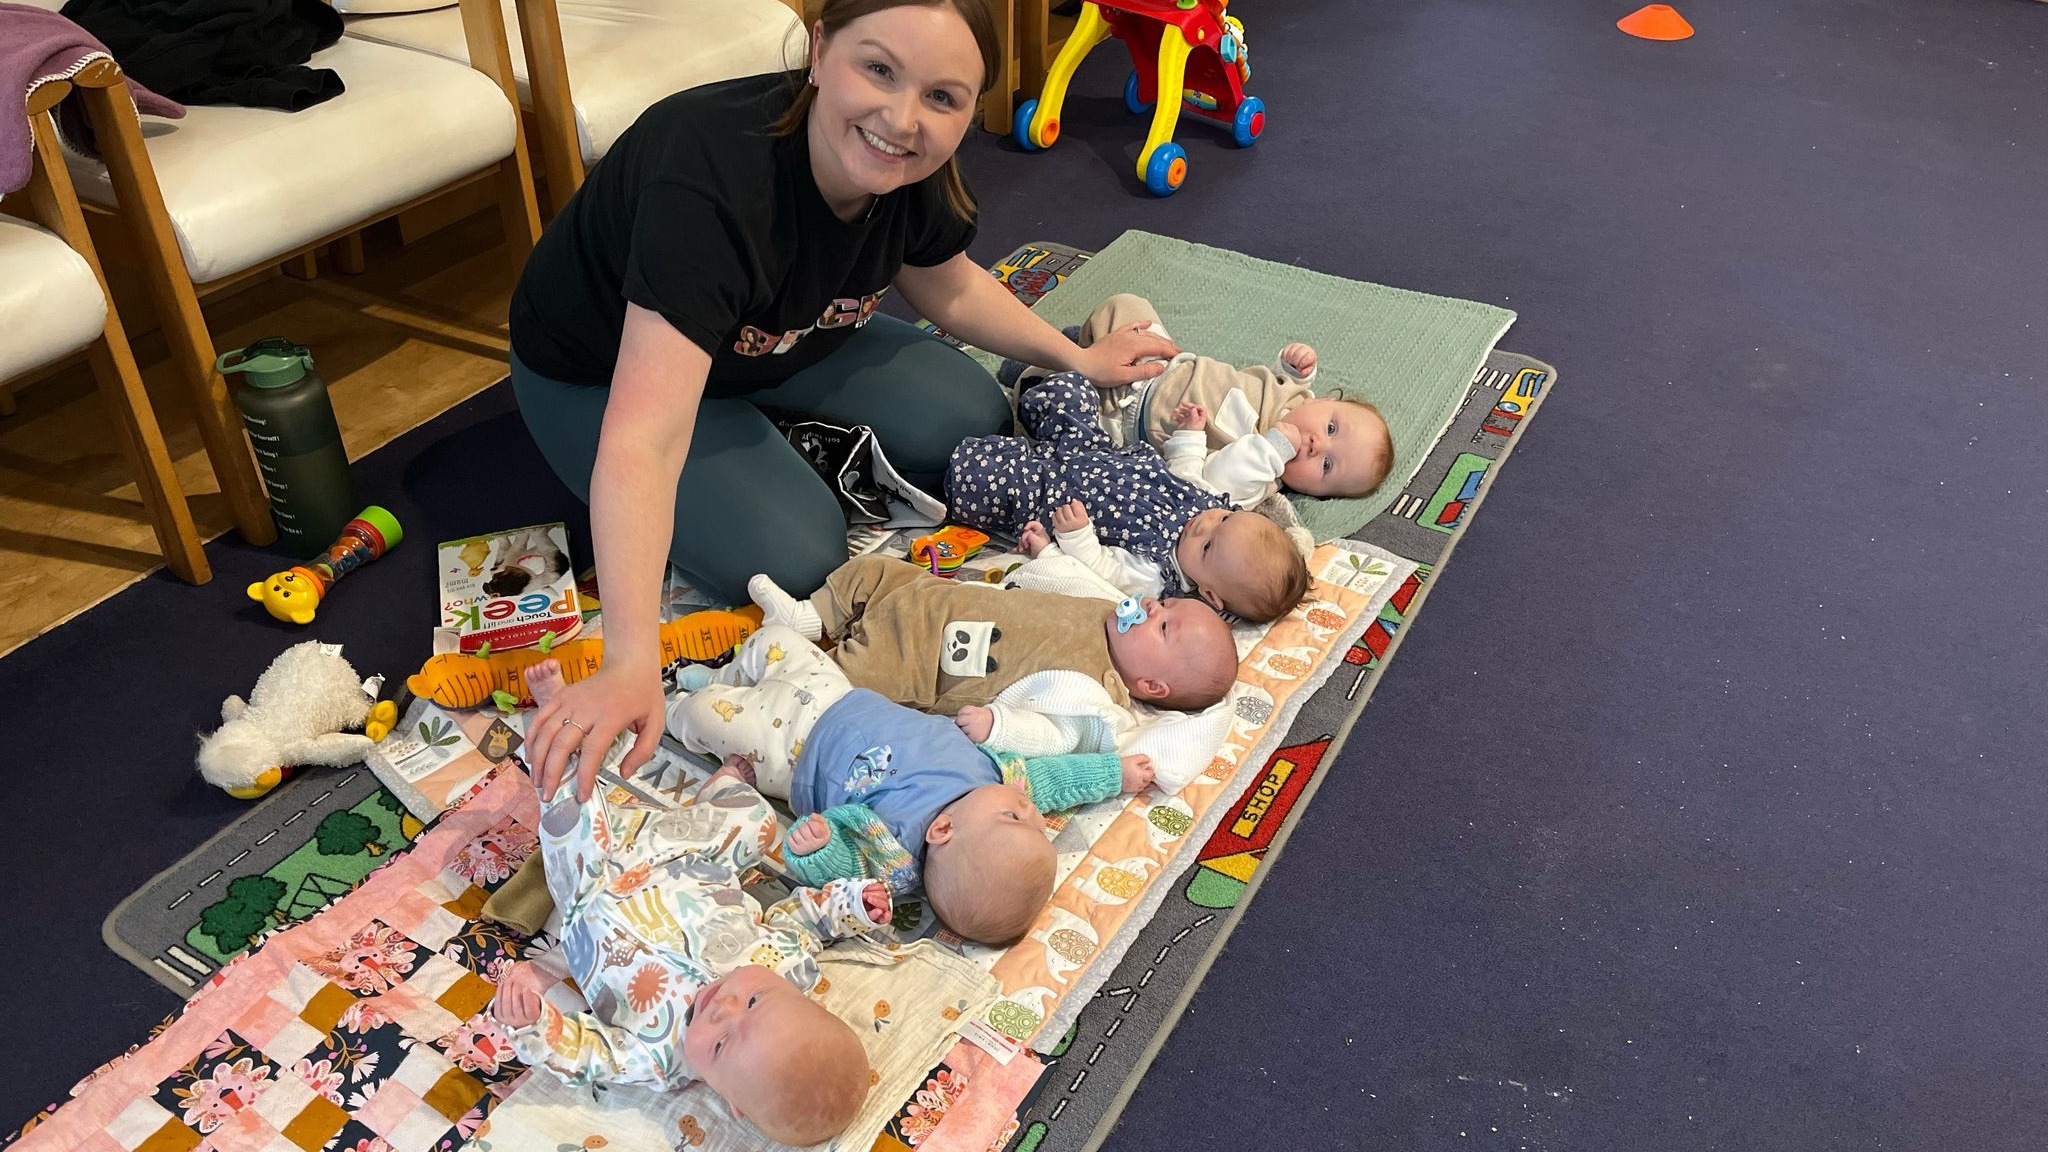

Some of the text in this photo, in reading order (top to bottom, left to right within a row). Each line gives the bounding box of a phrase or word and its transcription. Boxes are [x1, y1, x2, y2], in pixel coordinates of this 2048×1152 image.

[444, 595, 488, 611] who?
[483, 612, 553, 631] Touch and lift
[1242, 773, 1280, 822] SHOP
